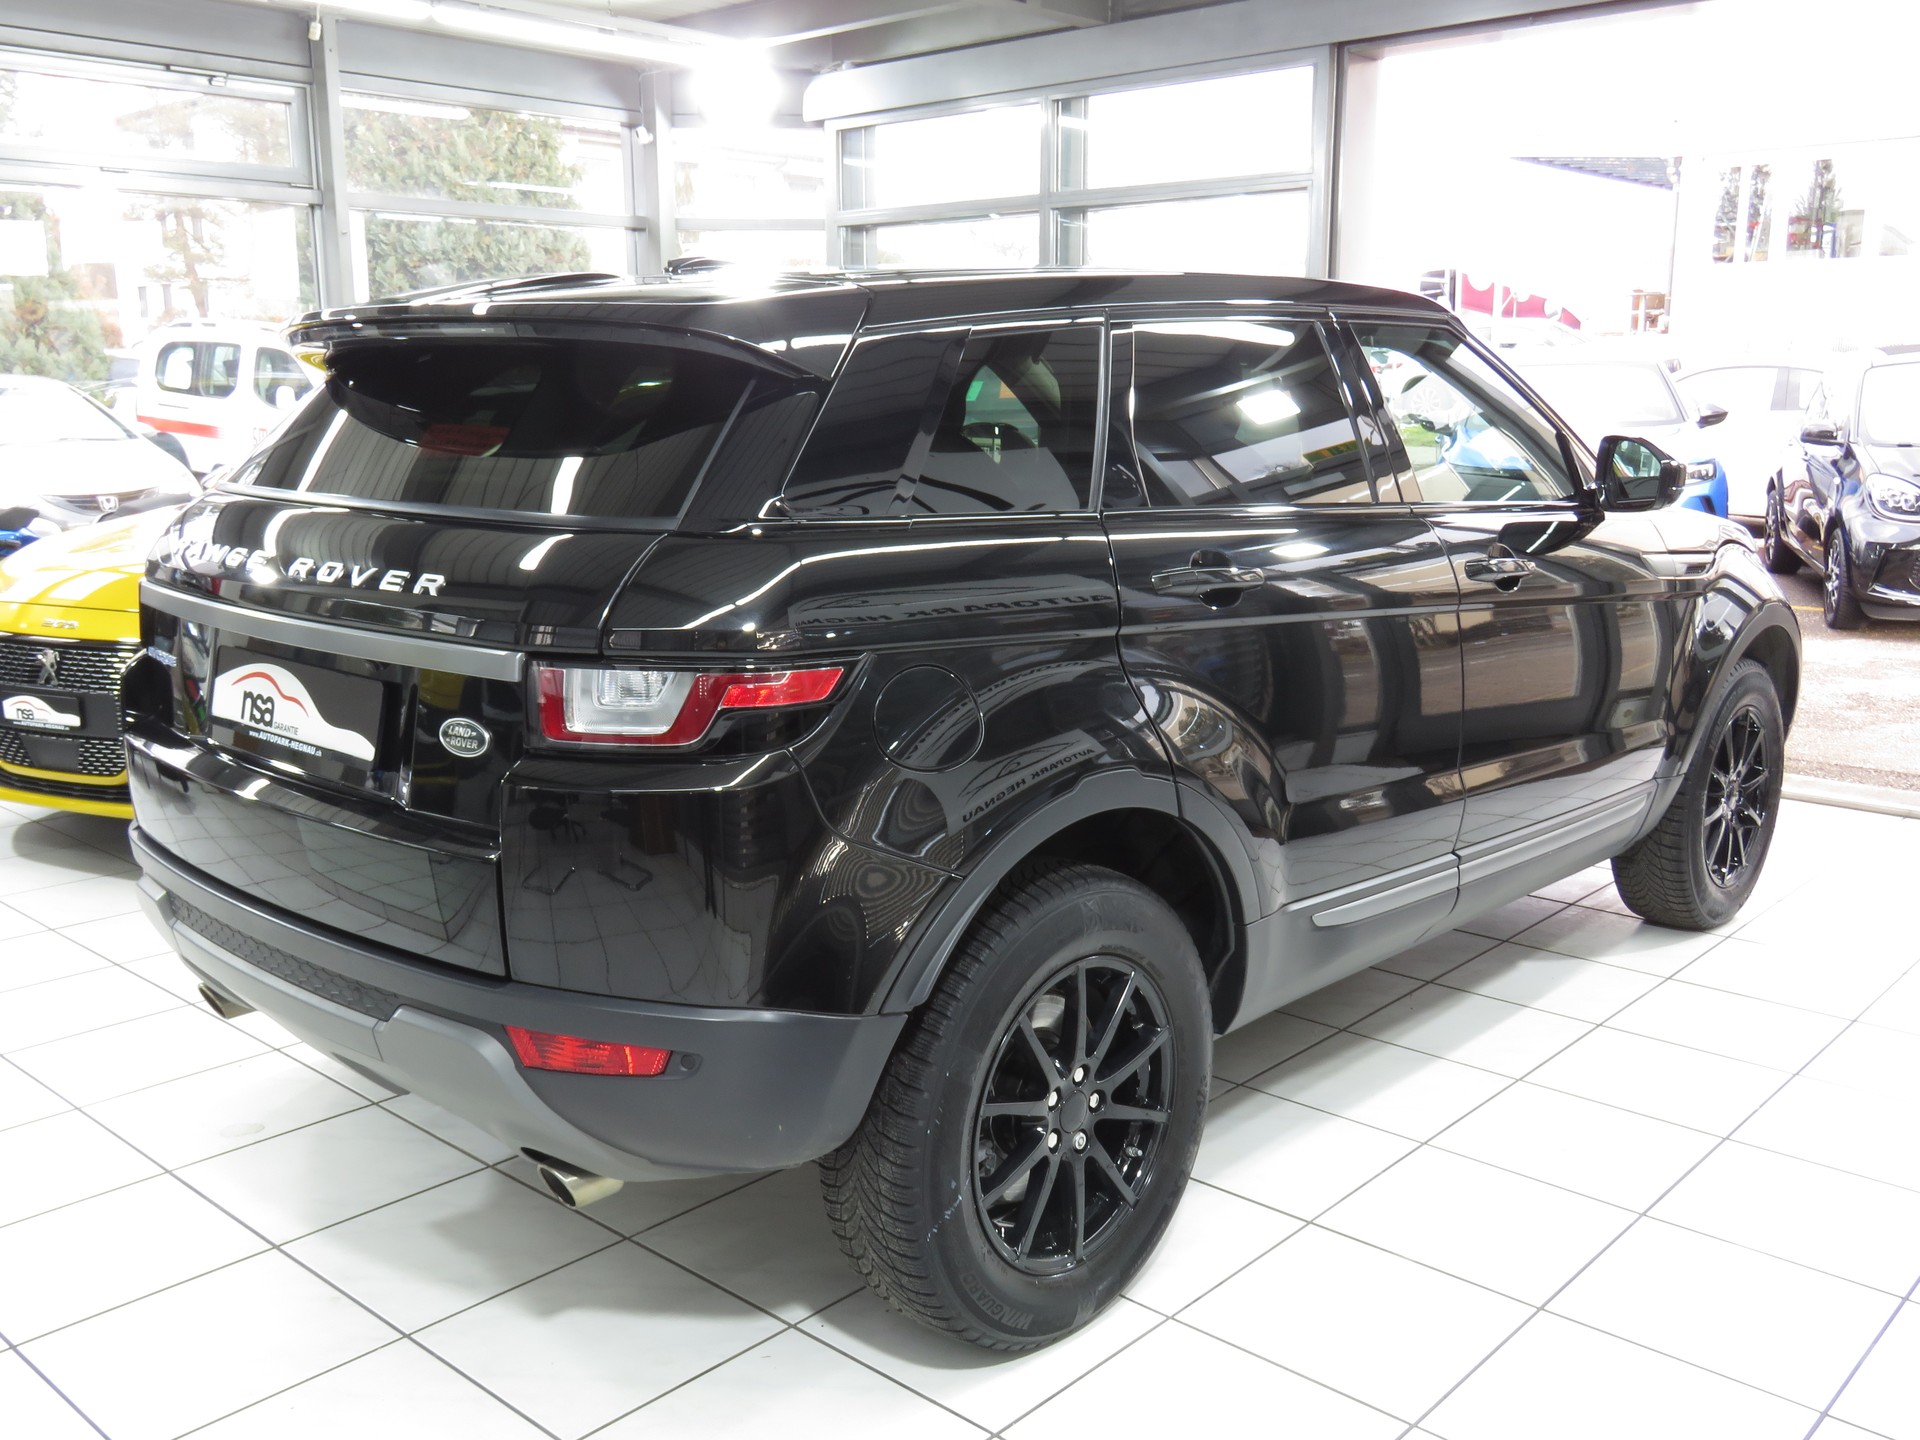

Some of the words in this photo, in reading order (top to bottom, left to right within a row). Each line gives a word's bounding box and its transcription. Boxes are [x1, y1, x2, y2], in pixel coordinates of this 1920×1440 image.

[288, 557, 446, 597] ROVER
[16, 708, 34, 720] nsa
[241, 690, 275, 728] nsa
[273, 722, 299, 736] GARANTIE
[960, 1272, 1034, 1330] WINGUARD
